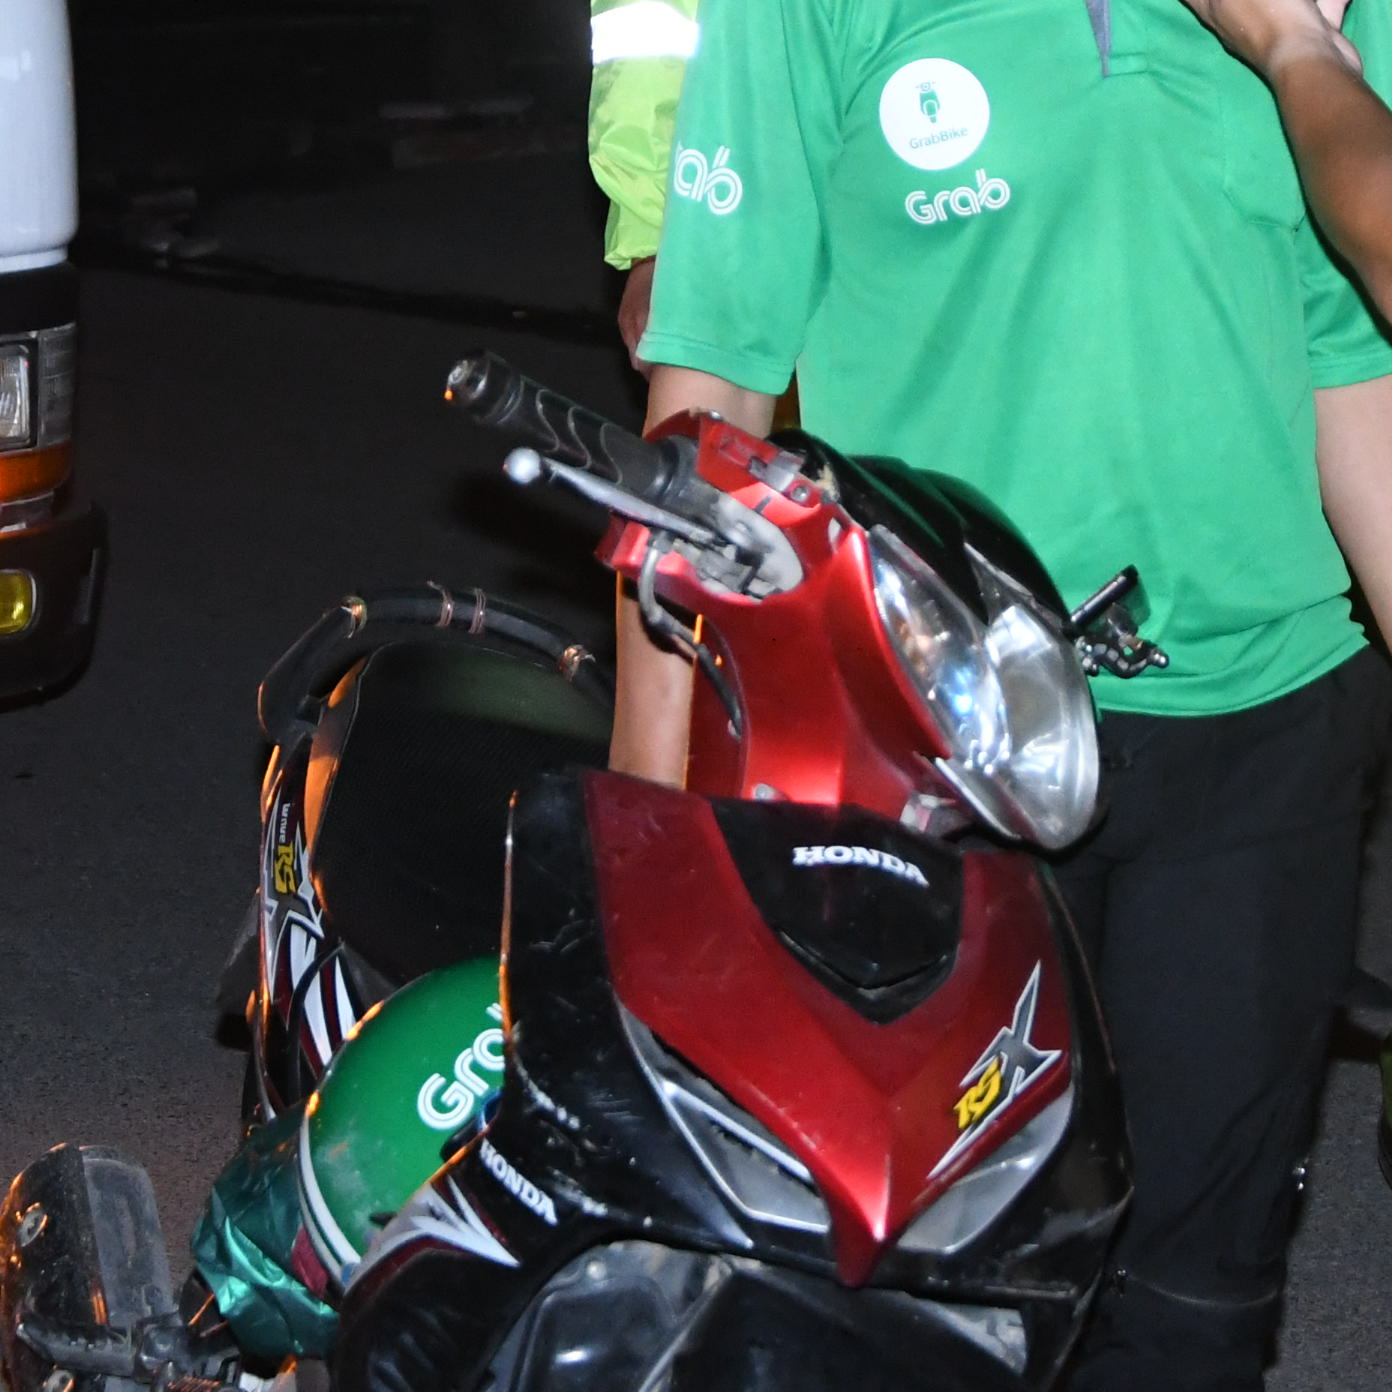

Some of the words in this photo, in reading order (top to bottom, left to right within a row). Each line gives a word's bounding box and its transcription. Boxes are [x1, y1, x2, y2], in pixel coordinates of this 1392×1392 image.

[908, 125, 969, 151] GrabBike
[673, 142, 743, 215] ab
[905, 168, 1011, 225] Grab
[792, 845, 930, 888] HONDA
[478, 1137, 559, 1226] HONDA
